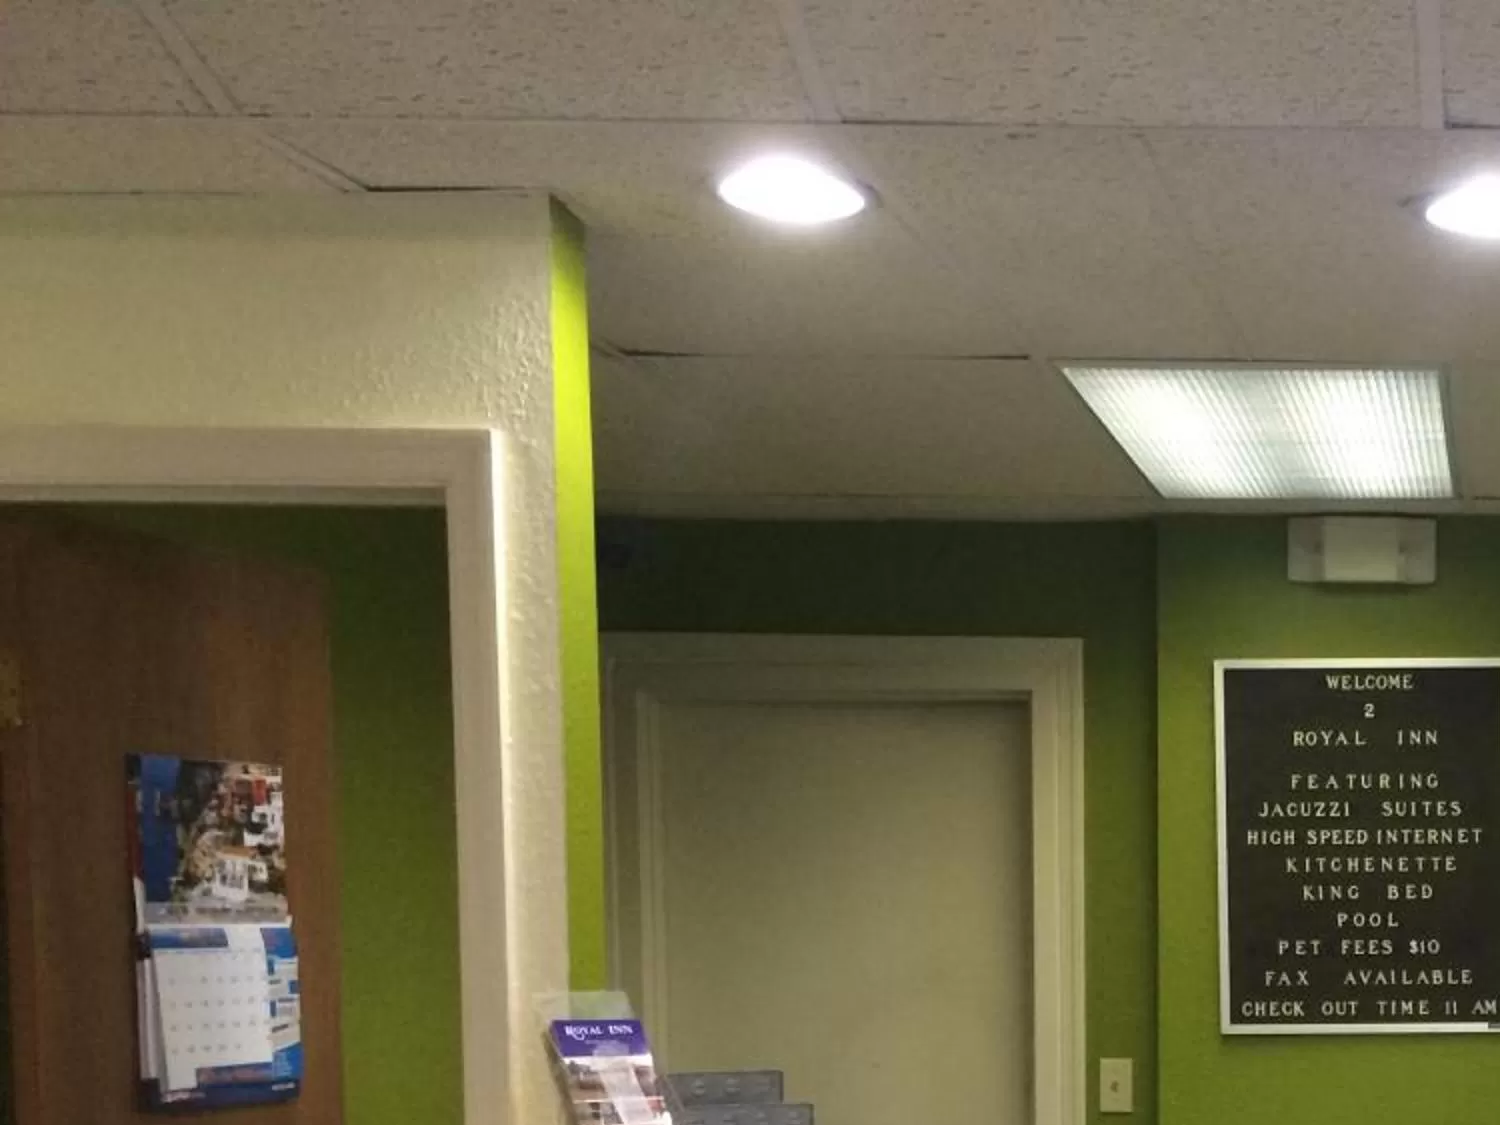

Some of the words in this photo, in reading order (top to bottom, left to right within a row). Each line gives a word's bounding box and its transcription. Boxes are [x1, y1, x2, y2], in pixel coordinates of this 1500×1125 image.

[1325, 674, 1414, 691] WELCOME
[1363, 702, 1376, 719] 2
[1292, 729, 1368, 747] ROYAL
[1397, 729, 1439, 746] INN
[1290, 772, 1440, 790] FEATURING
[1258, 801, 1351, 818] JACUZZI
[1380, 800, 1463, 817] SUITES
[1246, 829, 1296, 846] HIGH
[1306, 828, 1369, 845] SPEED
[1376, 828, 1483, 845] INTERNET
[1286, 855, 1458, 873] KITCHENETTE
[1302, 885, 1360, 901] KING
[1386, 883, 1434, 900] BED
[1336, 911, 1399, 928] POOL
[1277, 939, 1321, 956] PET
[1340, 939, 1393, 955] FEES
[1408, 938, 1441, 955] $10
[1264, 970, 1310, 986] FAX
[1343, 969, 1474, 986] AVAILABLE
[1241, 1001, 1306, 1017] CHECK
[1321, 1000, 1359, 1017] OUT
[1376, 999, 1430, 1016] TIME
[1471, 999, 1498, 1016] AM
